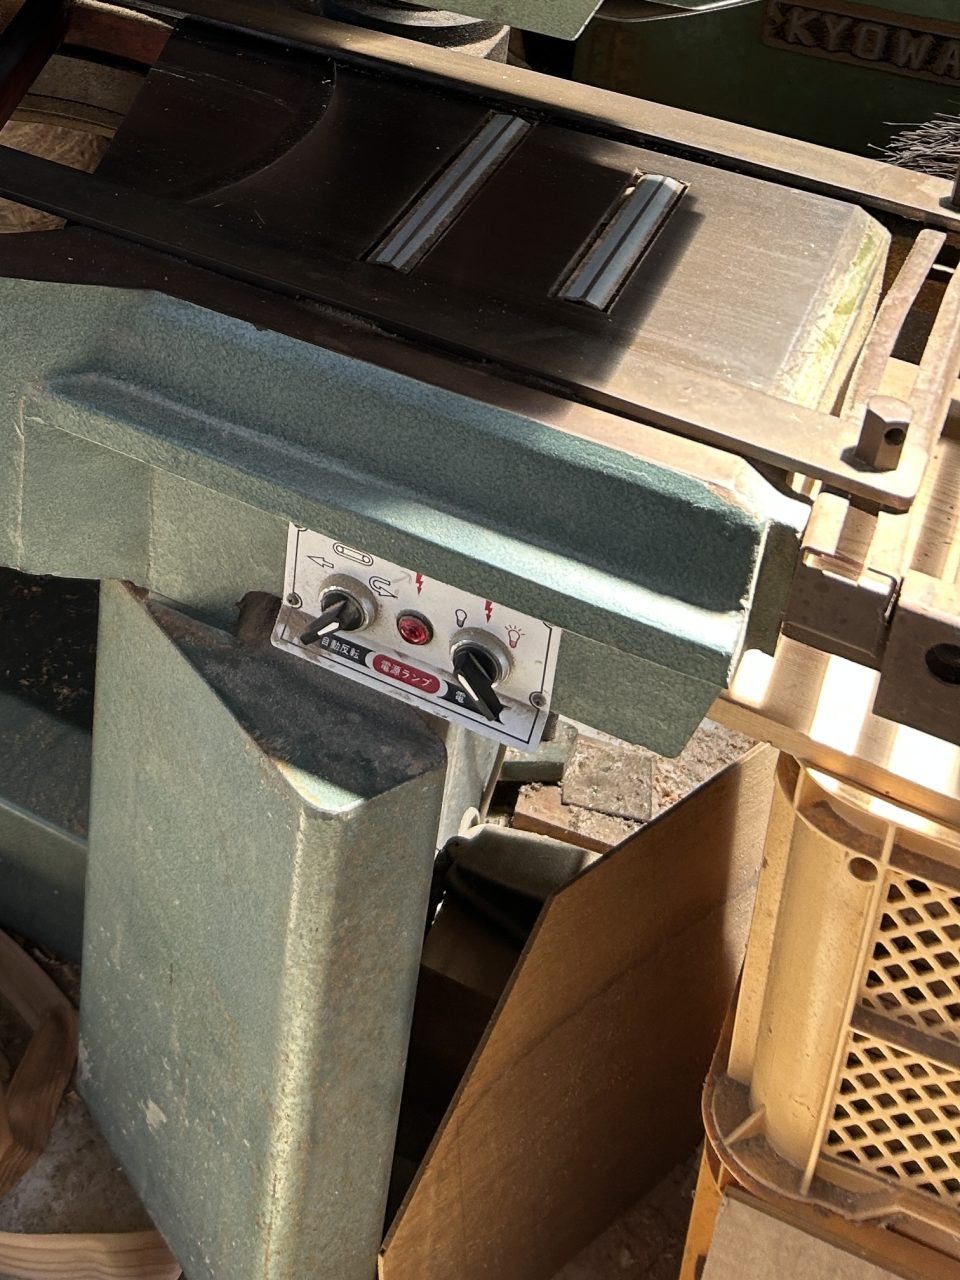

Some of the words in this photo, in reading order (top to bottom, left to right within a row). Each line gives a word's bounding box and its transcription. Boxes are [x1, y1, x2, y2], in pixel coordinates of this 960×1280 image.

[321, 636, 361, 660] 自動反転
[380, 659, 433, 687] 電源ランプ
